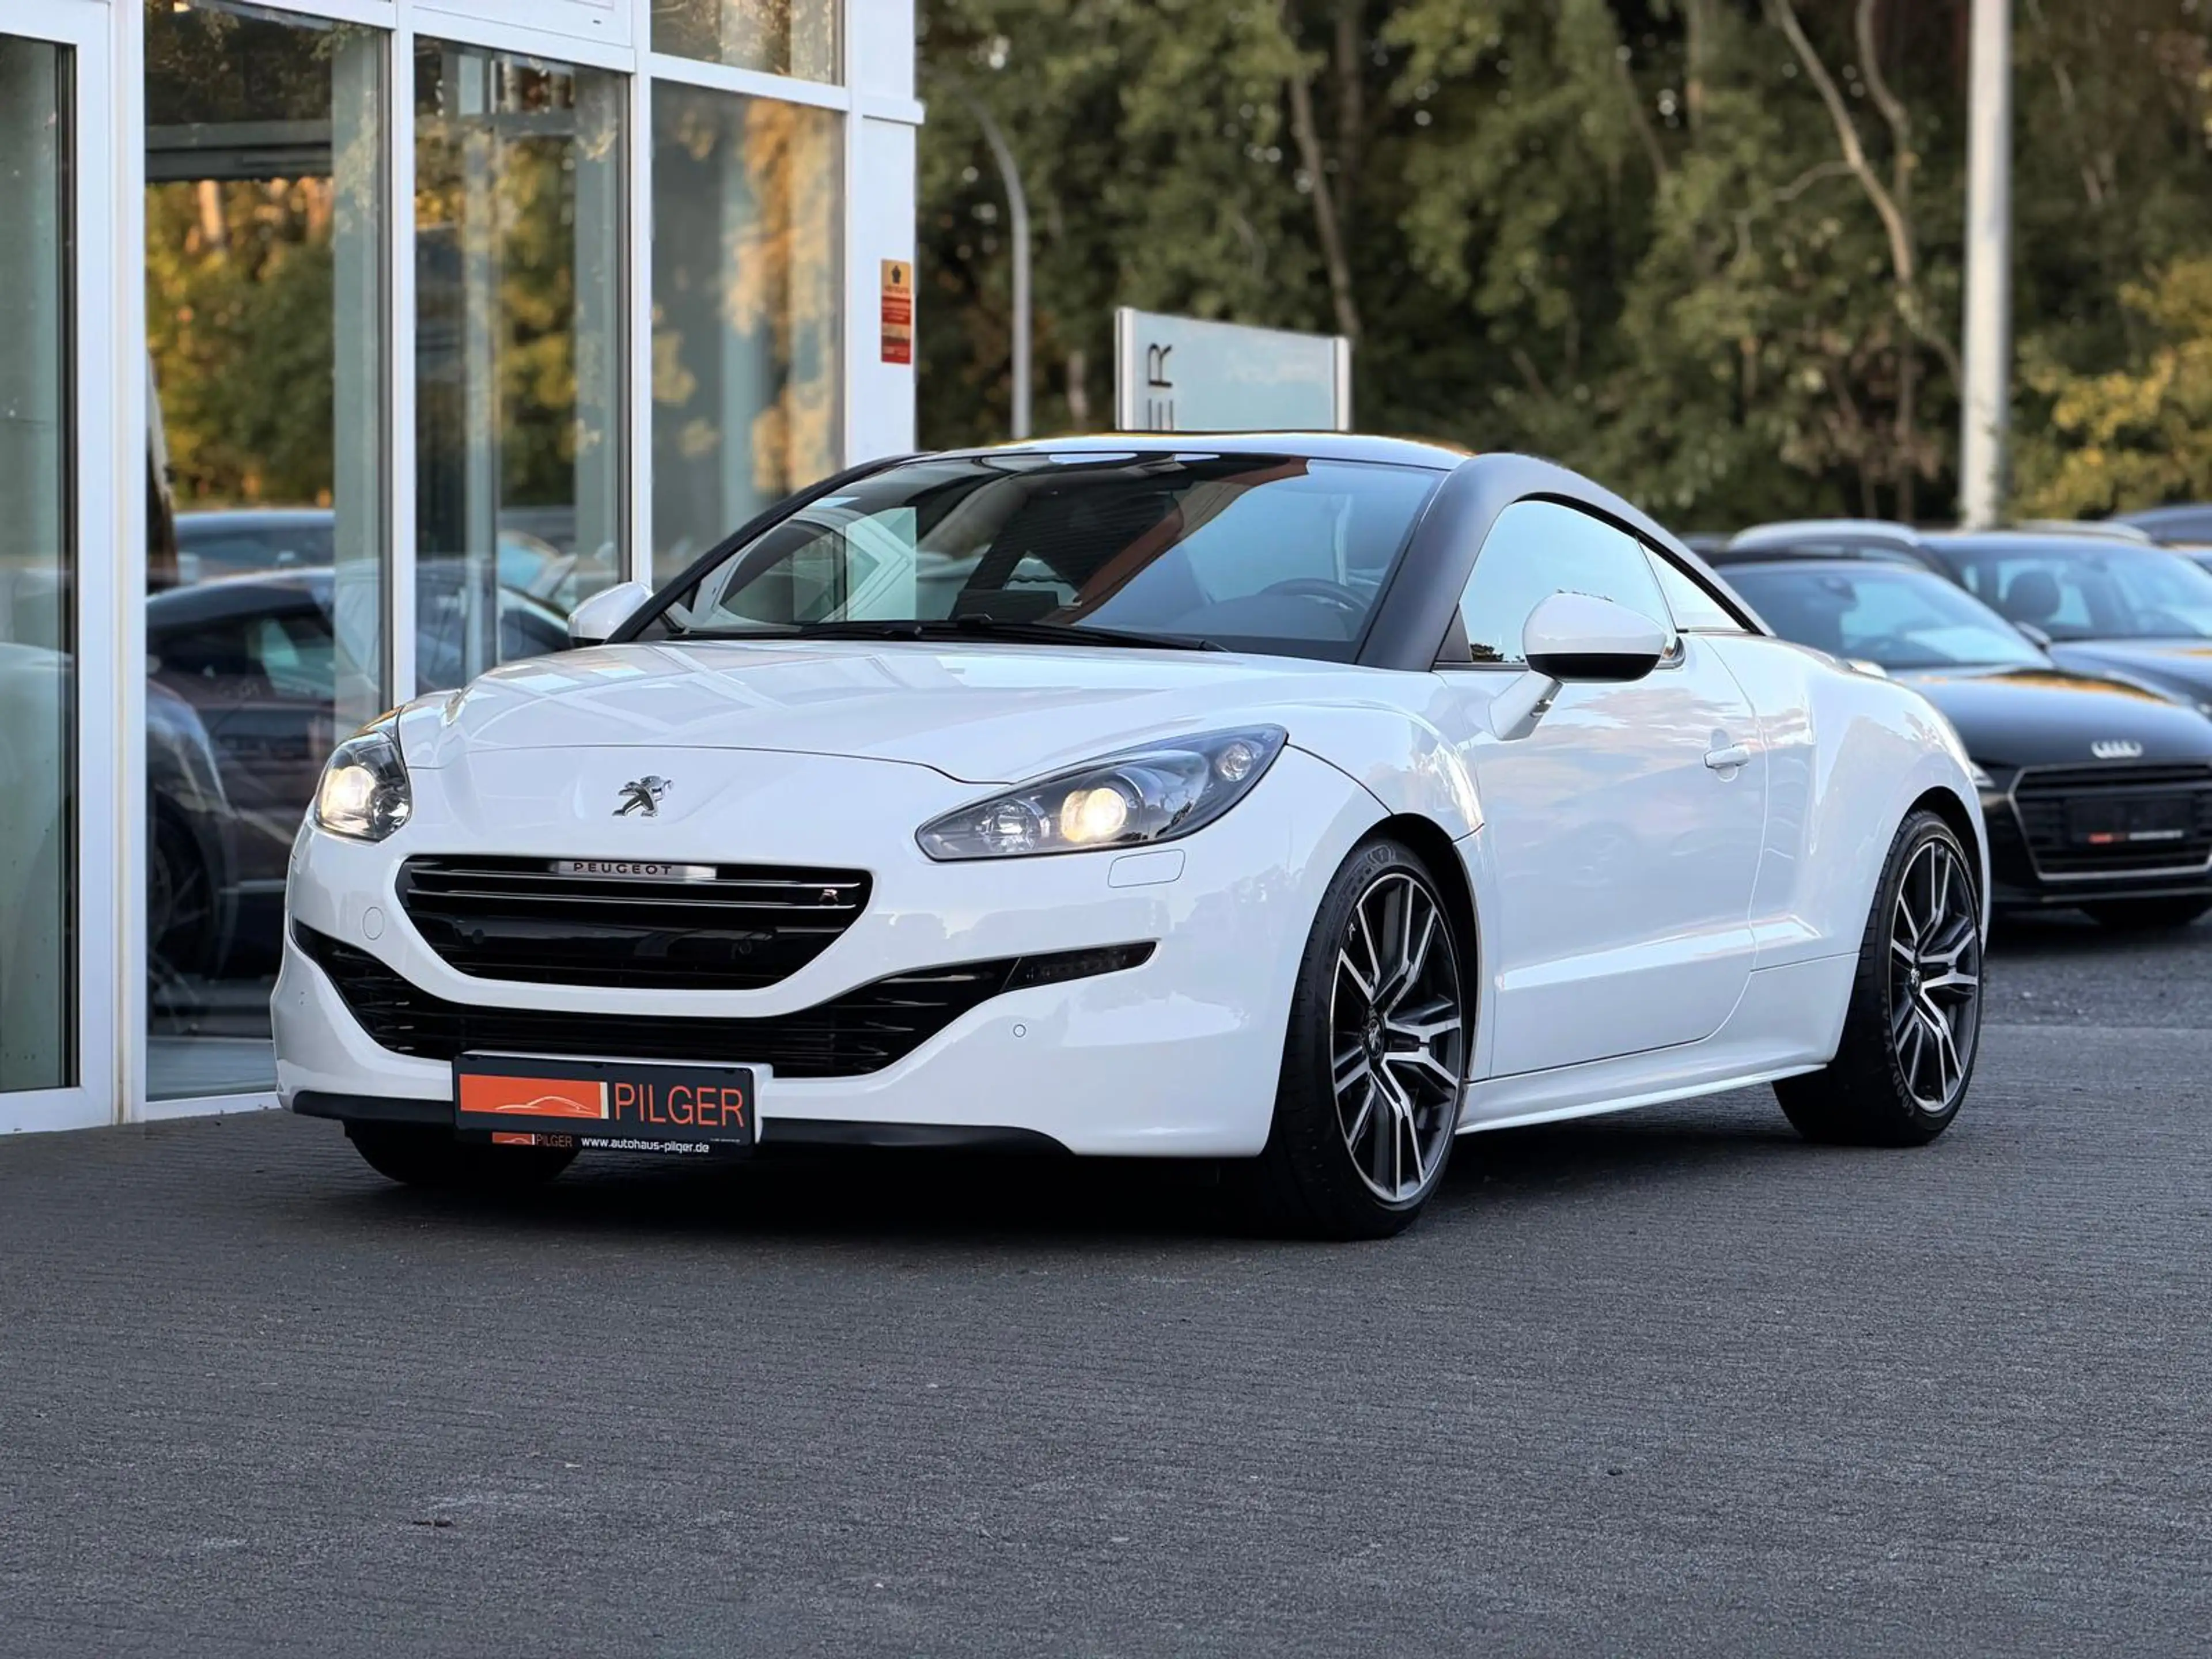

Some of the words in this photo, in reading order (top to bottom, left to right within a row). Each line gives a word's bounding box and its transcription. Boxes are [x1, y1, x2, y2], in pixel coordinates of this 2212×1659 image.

[573, 862, 672, 875] PEUGEOT
[615, 1082, 745, 1128] PILGER
[536, 1134, 573, 1147] PILGER
[581, 1137, 710, 1153] www.autohaus-pilger.de
